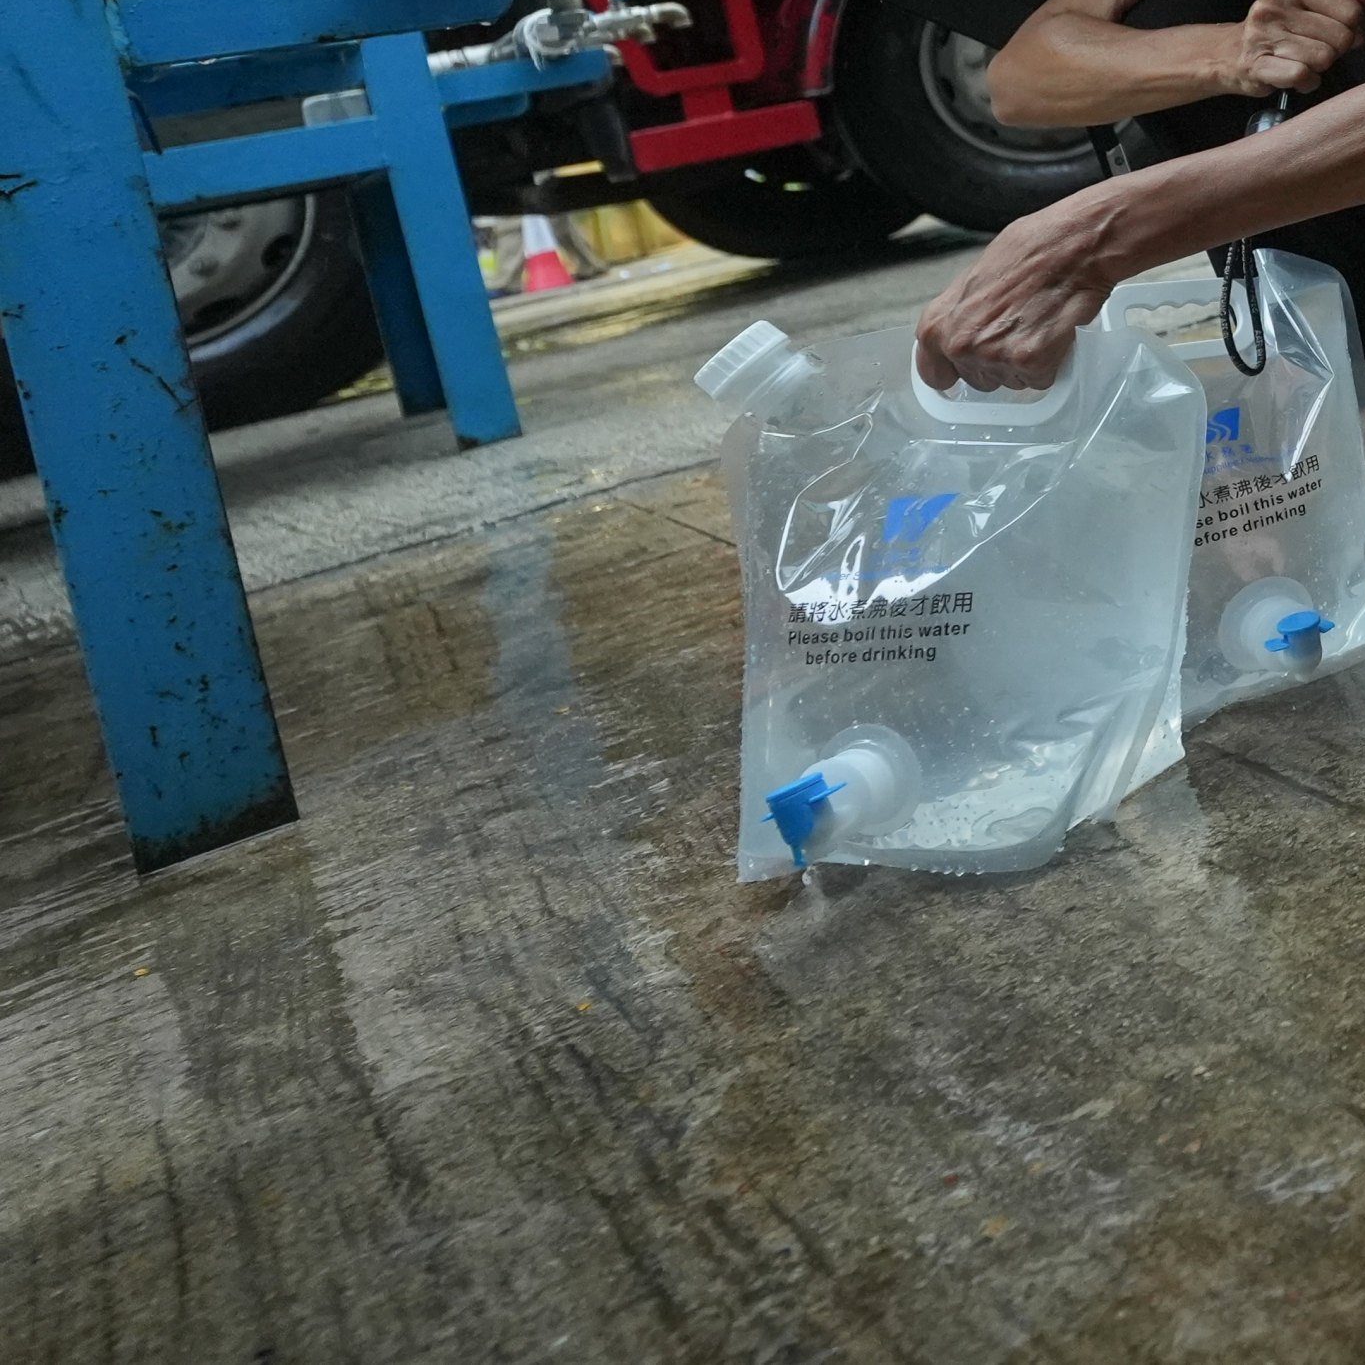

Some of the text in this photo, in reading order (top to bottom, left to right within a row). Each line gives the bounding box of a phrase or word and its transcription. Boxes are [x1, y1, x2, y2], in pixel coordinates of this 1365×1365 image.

[1218, 502, 1250, 522] boil
[1253, 494, 1285, 511] this
[1287, 478, 1323, 500] water
[1194, 503, 1307, 547] efore drinking
[787, 622, 971, 647] Please boil this water
[805, 644, 938, 666] before drinking
